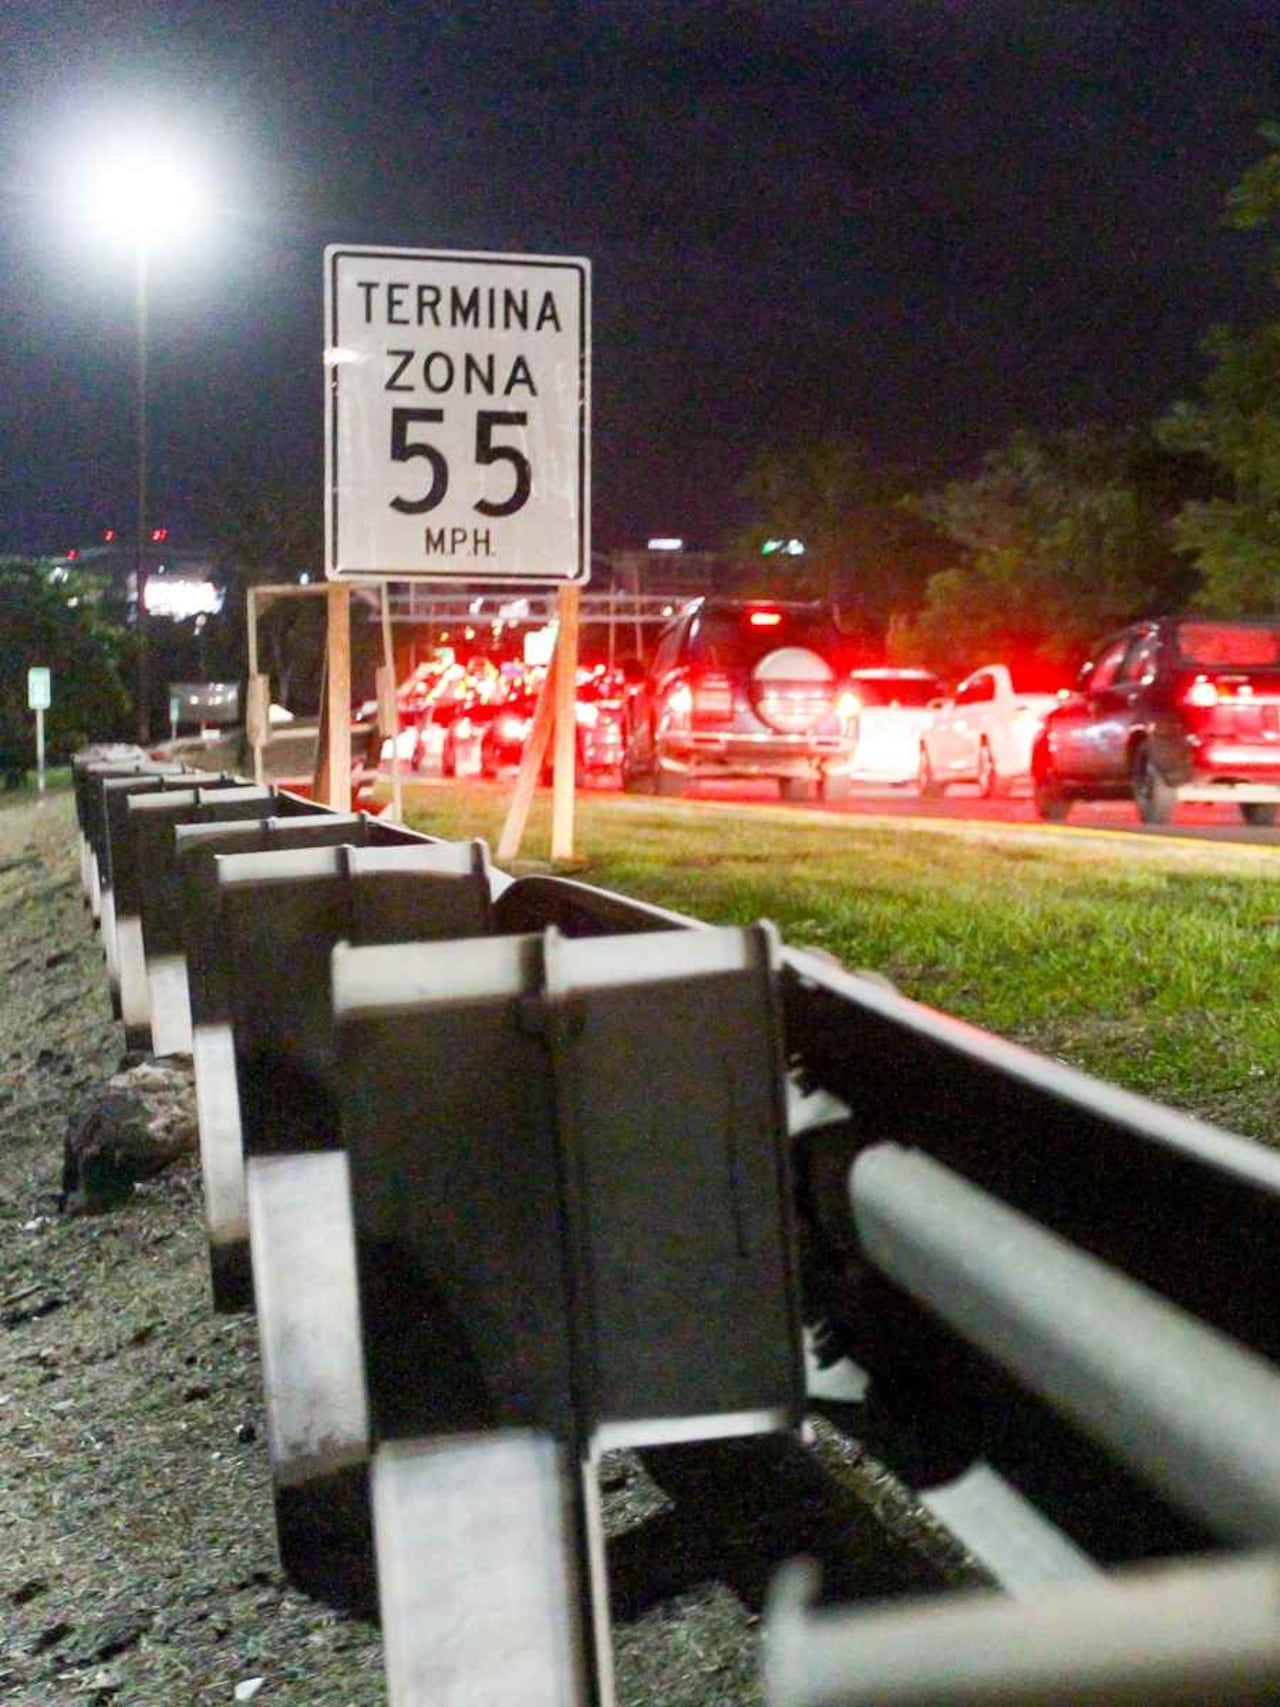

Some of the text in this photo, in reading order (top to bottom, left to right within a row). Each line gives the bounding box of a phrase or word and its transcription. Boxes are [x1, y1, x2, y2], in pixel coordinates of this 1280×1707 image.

[357, 281, 562, 333] TERMINA
[385, 350, 538, 397] ZONA
[389, 407, 533, 518] 55
